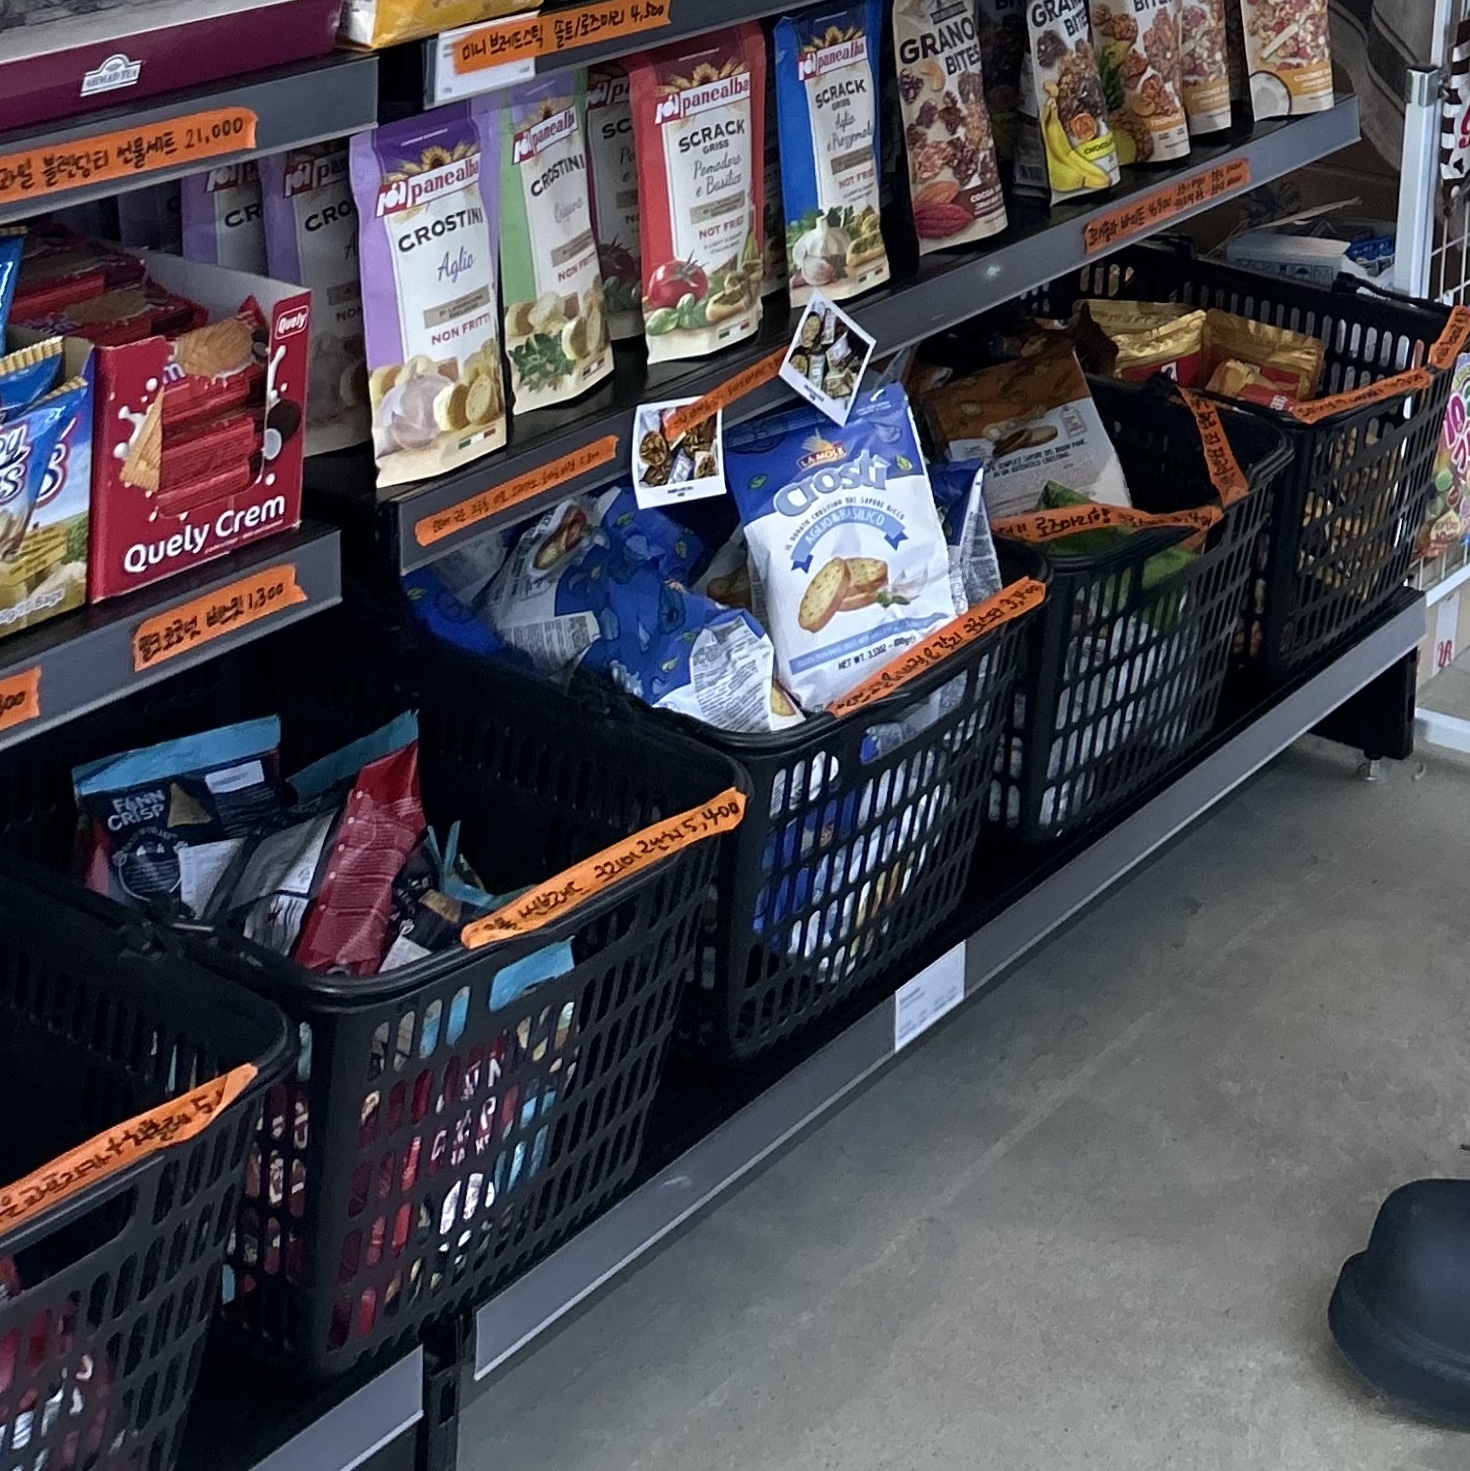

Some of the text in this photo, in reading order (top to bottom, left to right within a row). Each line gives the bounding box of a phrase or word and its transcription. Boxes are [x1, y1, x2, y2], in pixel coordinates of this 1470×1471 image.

[462, 40, 486, 62] 미니
[630, 1, 666, 25] 4,500
[817, 39, 865, 73] panealba
[681, 73, 751, 115] panealba
[815, 78, 867, 108] SCRACK
[831, 97, 851, 111] GRISS
[185, 114, 244, 150] 21,000
[679, 118, 745, 153] SCRACK
[703, 140, 730, 155] GRISS
[530, 154, 585, 197] CROSTINI
[693, 154, 743, 180] Pomodoro
[412, 162, 479, 204] panealba
[706, 171, 742, 197] Basilico
[838, 176, 856, 190] NOT
[398, 208, 484, 254] CROSTINI
[699, 223, 722, 240] NOT
[437, 245, 477, 284] Aglio
[558, 265, 576, 283] NON
[277, 312, 307, 335] Quely
[431, 323, 460, 347] NON
[799, 455, 816, 468] LA
[124, 495, 287, 576] Quely Crem
[112, 789, 166, 814] FINN
[108, 804, 165, 831] CRISP
[684, 799, 741, 841] 5,400
